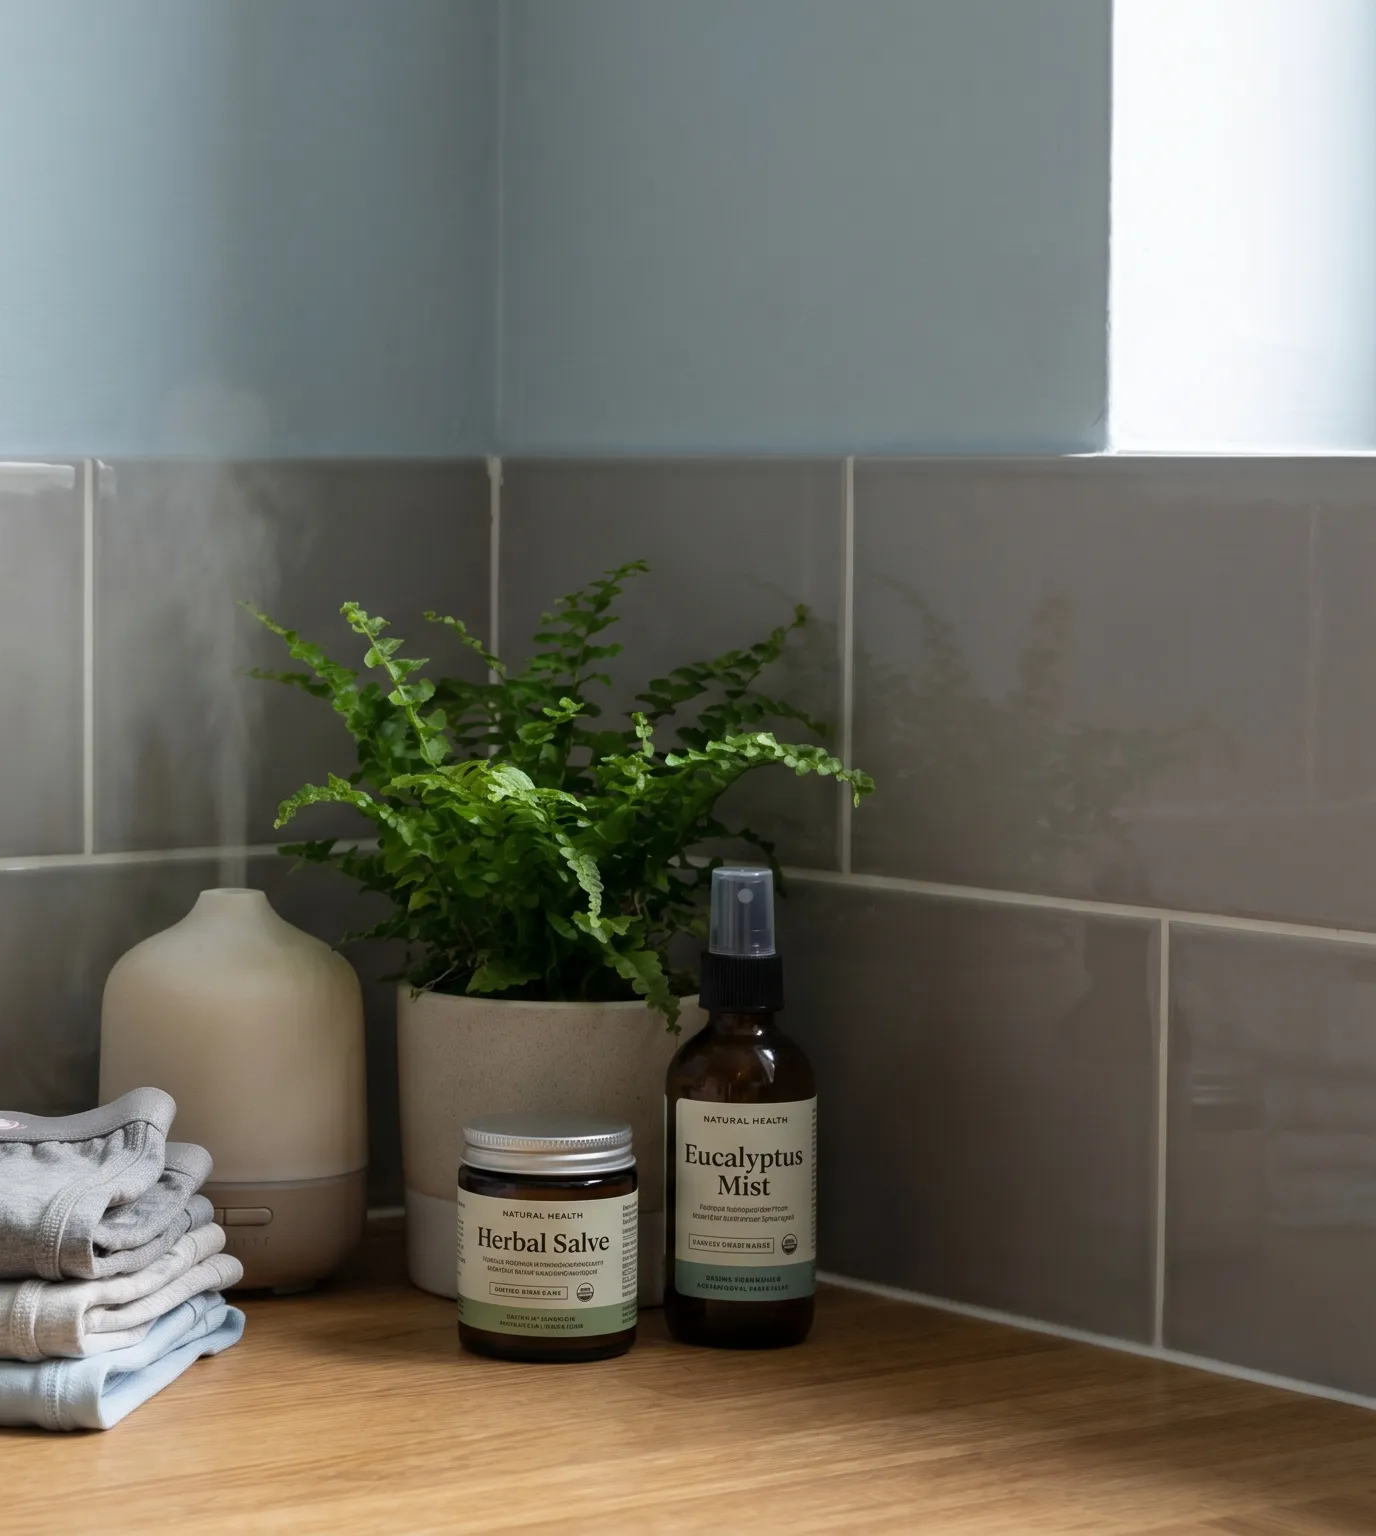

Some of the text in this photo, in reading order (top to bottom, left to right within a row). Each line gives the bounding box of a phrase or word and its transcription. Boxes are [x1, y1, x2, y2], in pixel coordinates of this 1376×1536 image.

[703, 1116, 788, 1125] NATURAL HEALTH
[685, 1143, 803, 1174] Eucalyptus
[718, 1175, 770, 1196] Mist
[502, 1211, 584, 1220] NATURAL HEALTH
[478, 1227, 609, 1253] Herbal Salve
